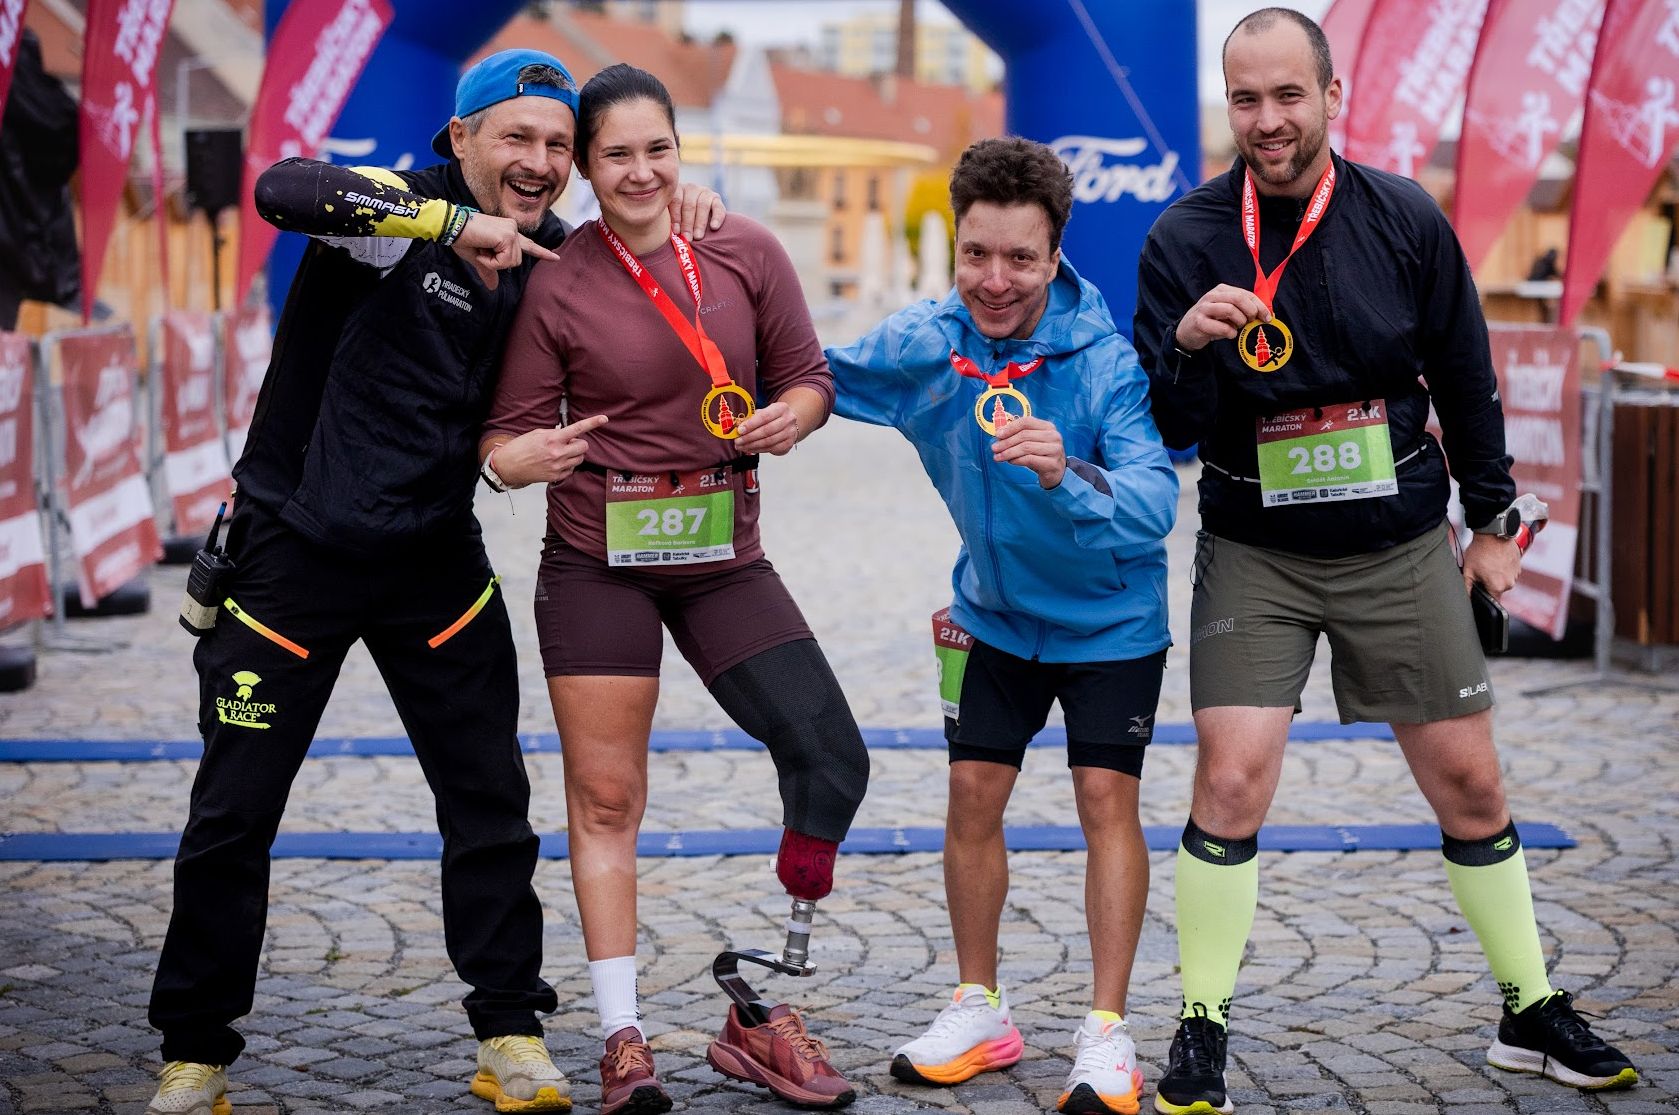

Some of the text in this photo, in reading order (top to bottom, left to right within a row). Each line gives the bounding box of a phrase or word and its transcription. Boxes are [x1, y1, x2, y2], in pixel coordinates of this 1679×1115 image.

[1052, 135, 1180, 203] Ford
[344, 191, 419, 218] SMMASH
[1244, 171, 1256, 249] EBÍČSKÝ MARATON
[608, 233, 643, 278] TŘEBÍČSKÝ
[441, 279, 471, 299] HRADECKÝ
[437, 289, 473, 313] PŮLMARATON
[700, 301, 727, 315] CRAFT
[1261, 405, 1381, 424] TEBÍČSKÝ 21K
[1261, 423, 1302, 433] MARATON
[1287, 441, 1362, 475] 288
[611, 485, 655, 493] MARATON
[612, 471, 728, 488] TŘBÍČSKÝ 21K
[636, 507, 708, 536] 287
[940, 627, 971, 646] 21K
[216, 697, 277, 714] GLADIATOR
